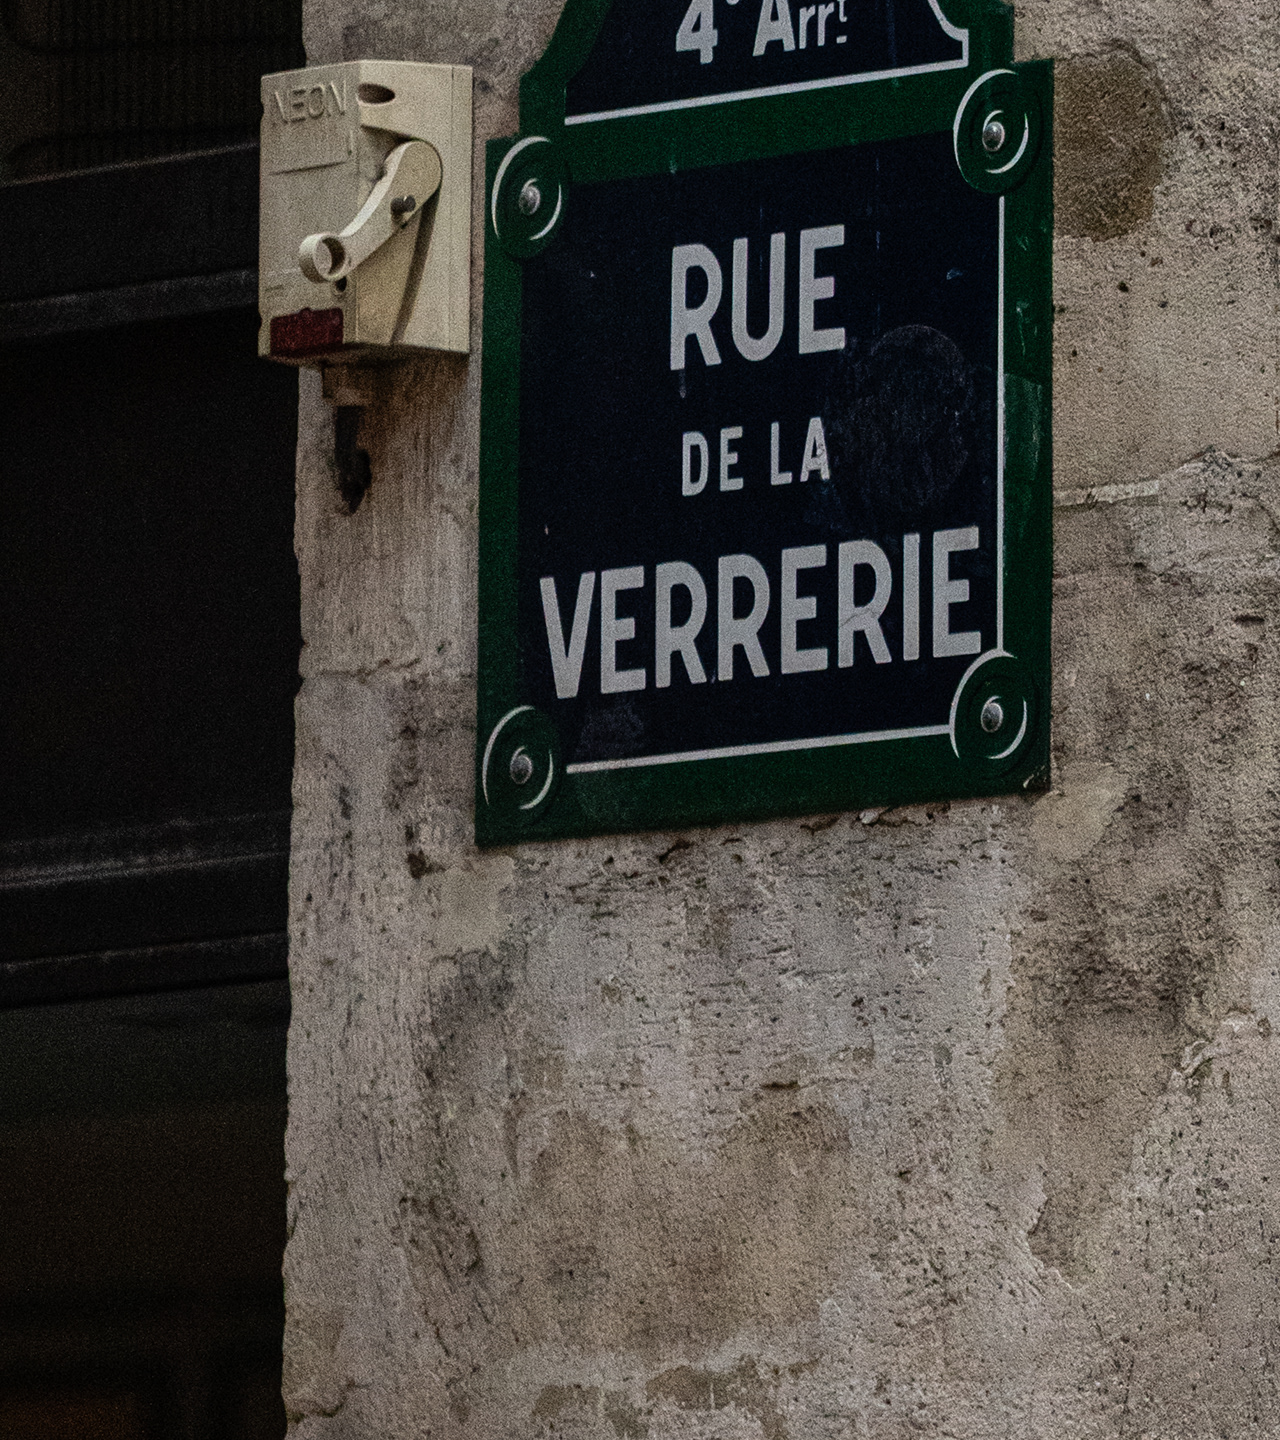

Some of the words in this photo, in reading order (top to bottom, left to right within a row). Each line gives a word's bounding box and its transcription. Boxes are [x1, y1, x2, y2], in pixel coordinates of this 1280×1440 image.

[670, 224, 846, 371] RUE
[682, 424, 744, 497] DE
[770, 417, 831, 486] LA
[539, 526, 981, 700] VERRERIE
